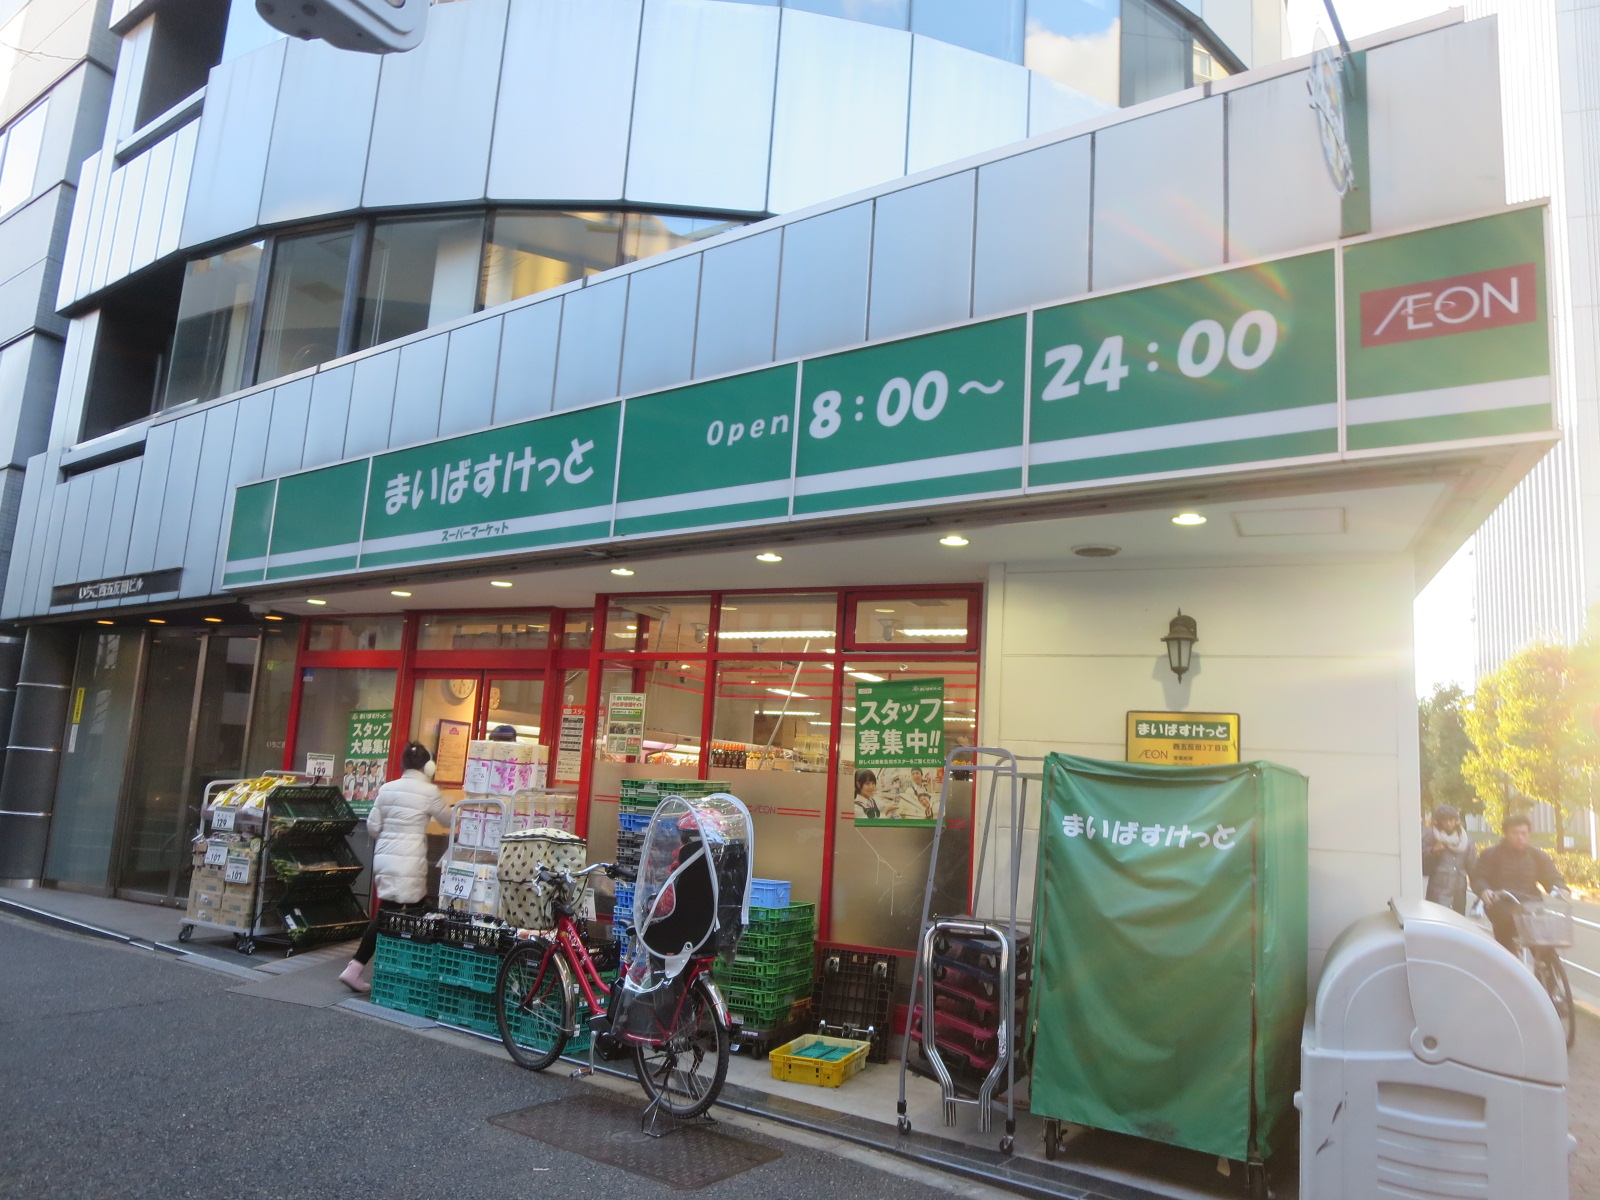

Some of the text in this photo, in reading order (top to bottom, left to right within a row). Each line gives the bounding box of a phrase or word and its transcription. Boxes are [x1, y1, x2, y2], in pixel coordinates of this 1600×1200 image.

[706, 414, 789, 446] Open
[384, 437, 595, 516] まいばすけっと
[441, 521, 509, 542] スーパーマーケット
[859, 698, 942, 726] スタッフ
[352, 722, 393, 737] スタッフ
[858, 728, 942, 755] 募集中!!
[1137, 722, 1228, 738] まいばすけっと
[1061, 813, 1236, 850] まいばすけっと
[454, 884, 464, 894] 99
